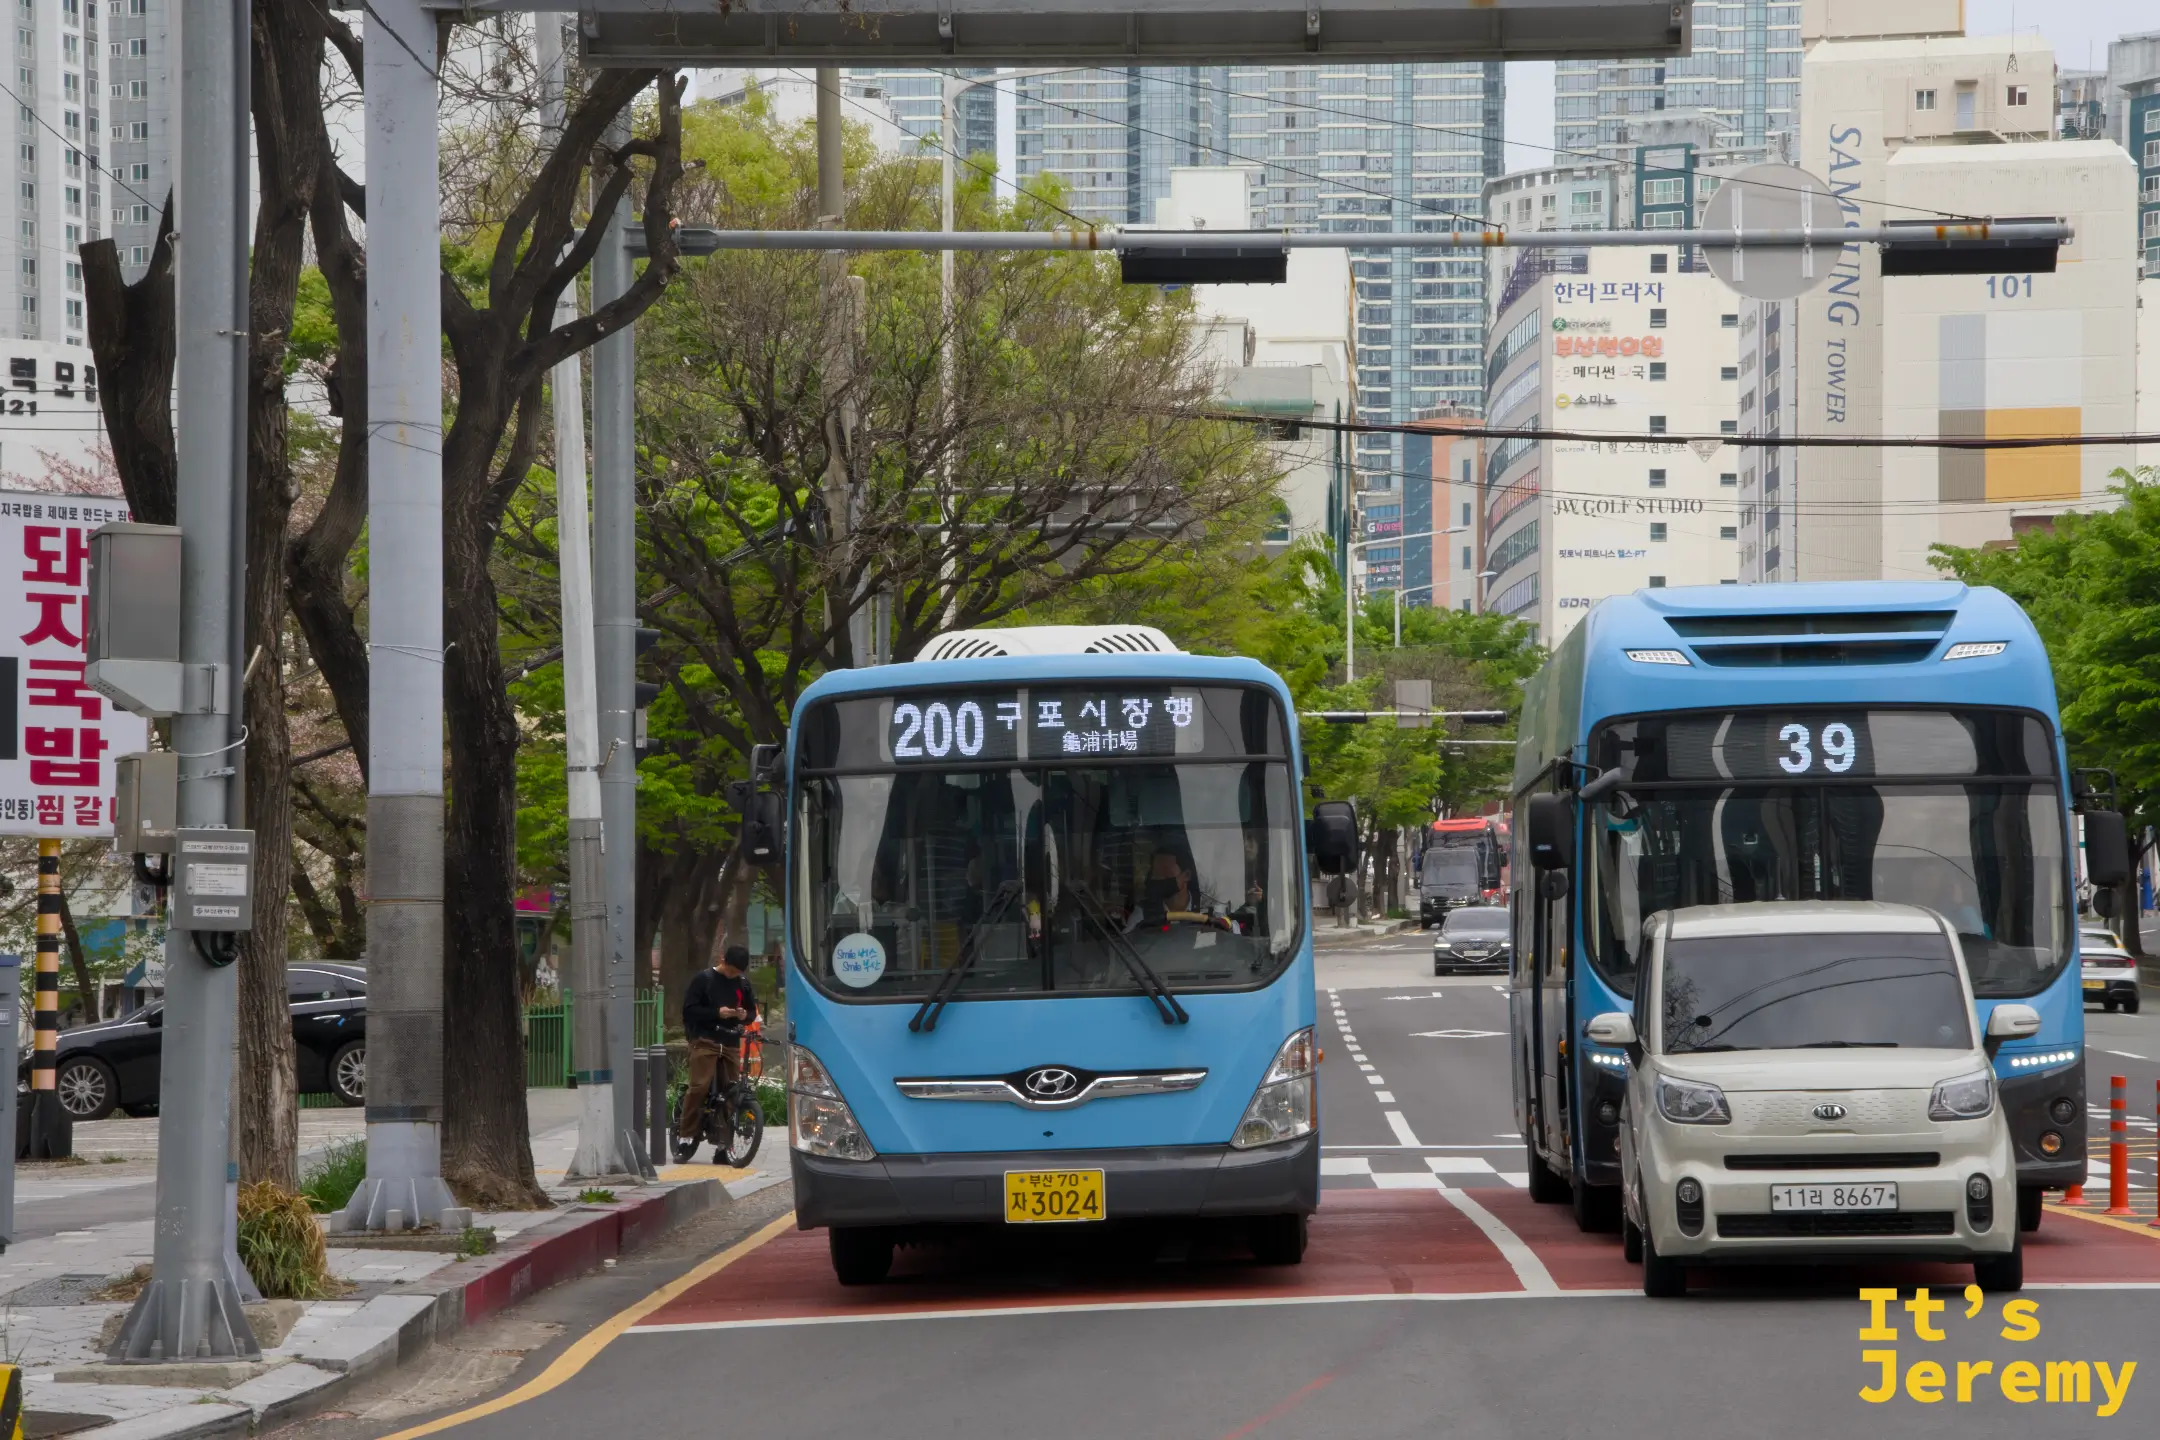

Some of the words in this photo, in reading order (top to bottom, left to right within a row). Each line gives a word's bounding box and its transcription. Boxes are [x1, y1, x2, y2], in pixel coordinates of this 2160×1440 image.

[1553, 282, 1666, 304] 한라프라자
[1986, 275, 2033, 299] 101
[1827, 338, 1847, 423] TOWER
[1, 502, 43, 519] 지국밥을
[48, 505, 78, 521] 제대로
[83, 507, 113, 523] 만드는
[1553, 499, 1579, 516] JW
[1583, 498, 1632, 515] GOLF
[1636, 498, 1703, 515] STUDIO
[1584, 549, 1616, 558] 피트니스
[1559, 597, 1591, 609] GDR
[894, 701, 984, 757] 200
[1778, 723, 1856, 774] 39
[0, 798, 34, 820] 인동)
[837, 948, 857, 960] Smile
[842, 961, 861, 972] Smile
[1815, 1104, 1844, 1118] KIA
[1029, 1174, 1053, 1188] 부산
[1057, 1173, 1079, 1187] 70
[1784, 1188, 1823, 1207] 11러
[1833, 1187, 1886, 1206] 8667
